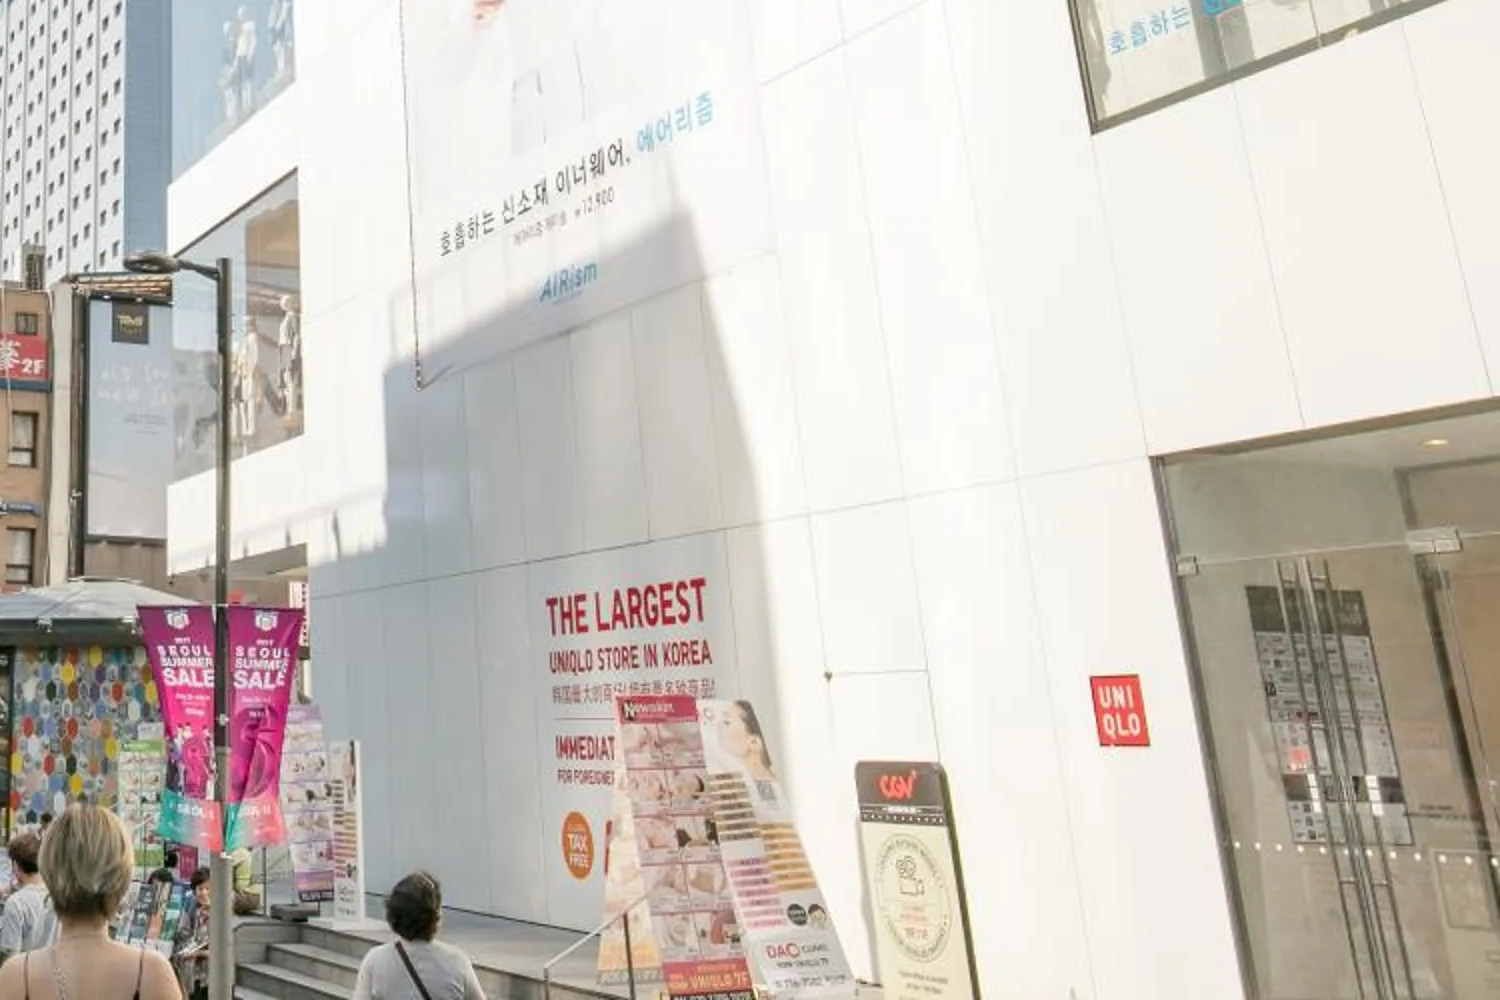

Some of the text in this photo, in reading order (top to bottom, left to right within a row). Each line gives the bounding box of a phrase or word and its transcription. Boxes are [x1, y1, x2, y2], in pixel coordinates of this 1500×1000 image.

[1110, 5, 1191, 55] 호흡하는
[440, 211, 496, 257] 호흡하는
[501, 177, 549, 226] 신소재
[636, 90, 714, 153] 에어리즘
[538, 262, 598, 302] AIRism
[20, 358, 46, 375] 2F
[546, 576, 707, 637] THE LARGEST
[157, 644, 213, 658] SEOUL
[160, 656, 214, 668] SUMMER
[235, 646, 291, 658] SEOUL
[549, 638, 713, 677] UNIQLO STORE IN KOREA
[163, 667, 215, 688] SALE
[234, 668, 288, 690] SALE
[1098, 686, 1137, 708] UNI
[1102, 712, 1142, 740] QLO
[555, 735, 616, 761] IMMEDIAT
[557, 769, 573, 785] FOR
[878, 773, 914, 799] CGV
[567, 833, 589, 854] TAX
[569, 853, 591, 868] FREE
